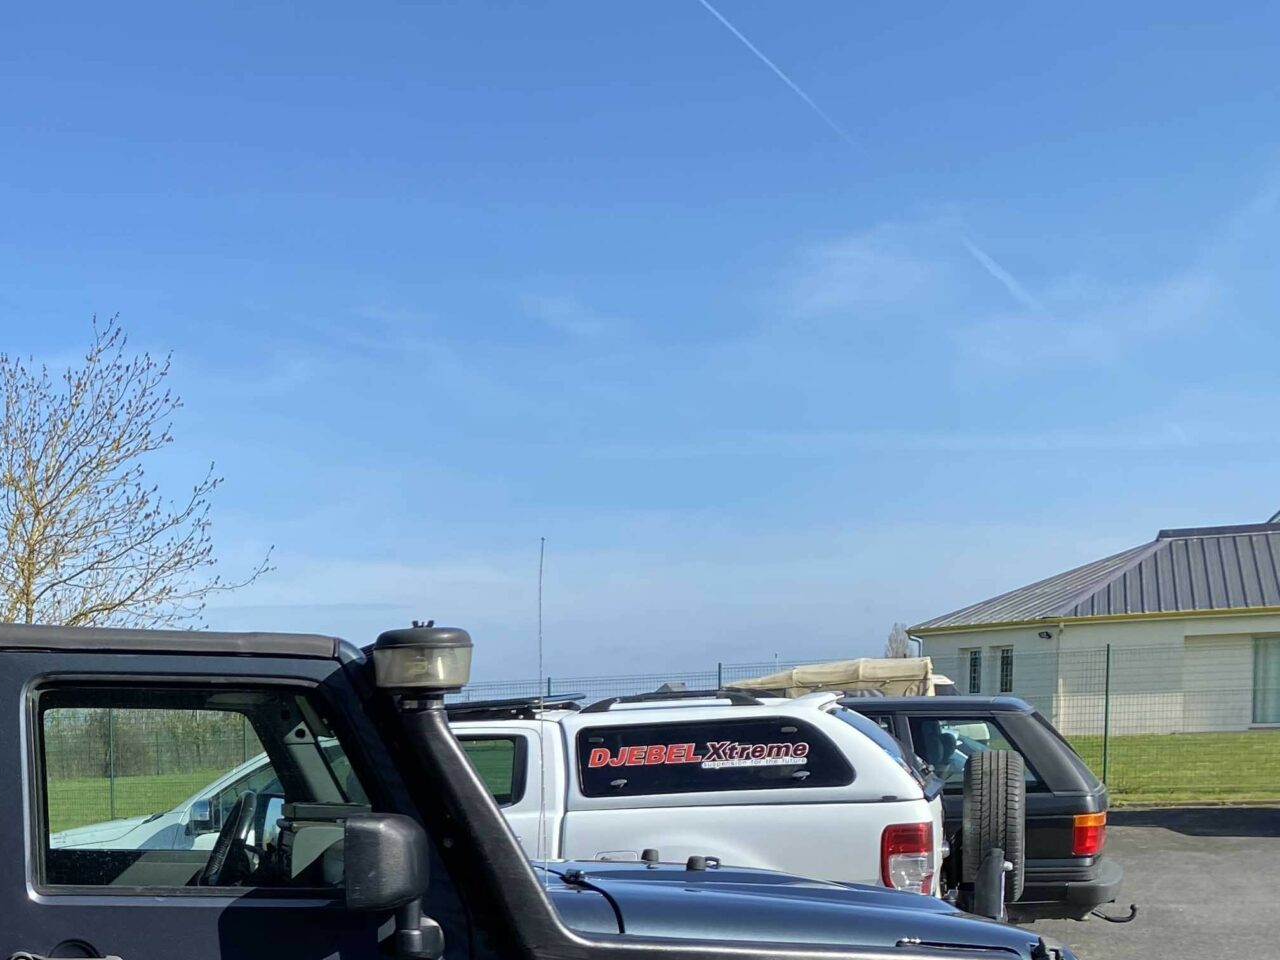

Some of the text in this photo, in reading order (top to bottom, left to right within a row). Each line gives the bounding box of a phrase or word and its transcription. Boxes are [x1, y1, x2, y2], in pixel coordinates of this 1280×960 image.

[588, 740, 809, 768] DJEBEL Xtreme
[703, 761, 747, 769] suspension
[751, 758, 763, 766] for
